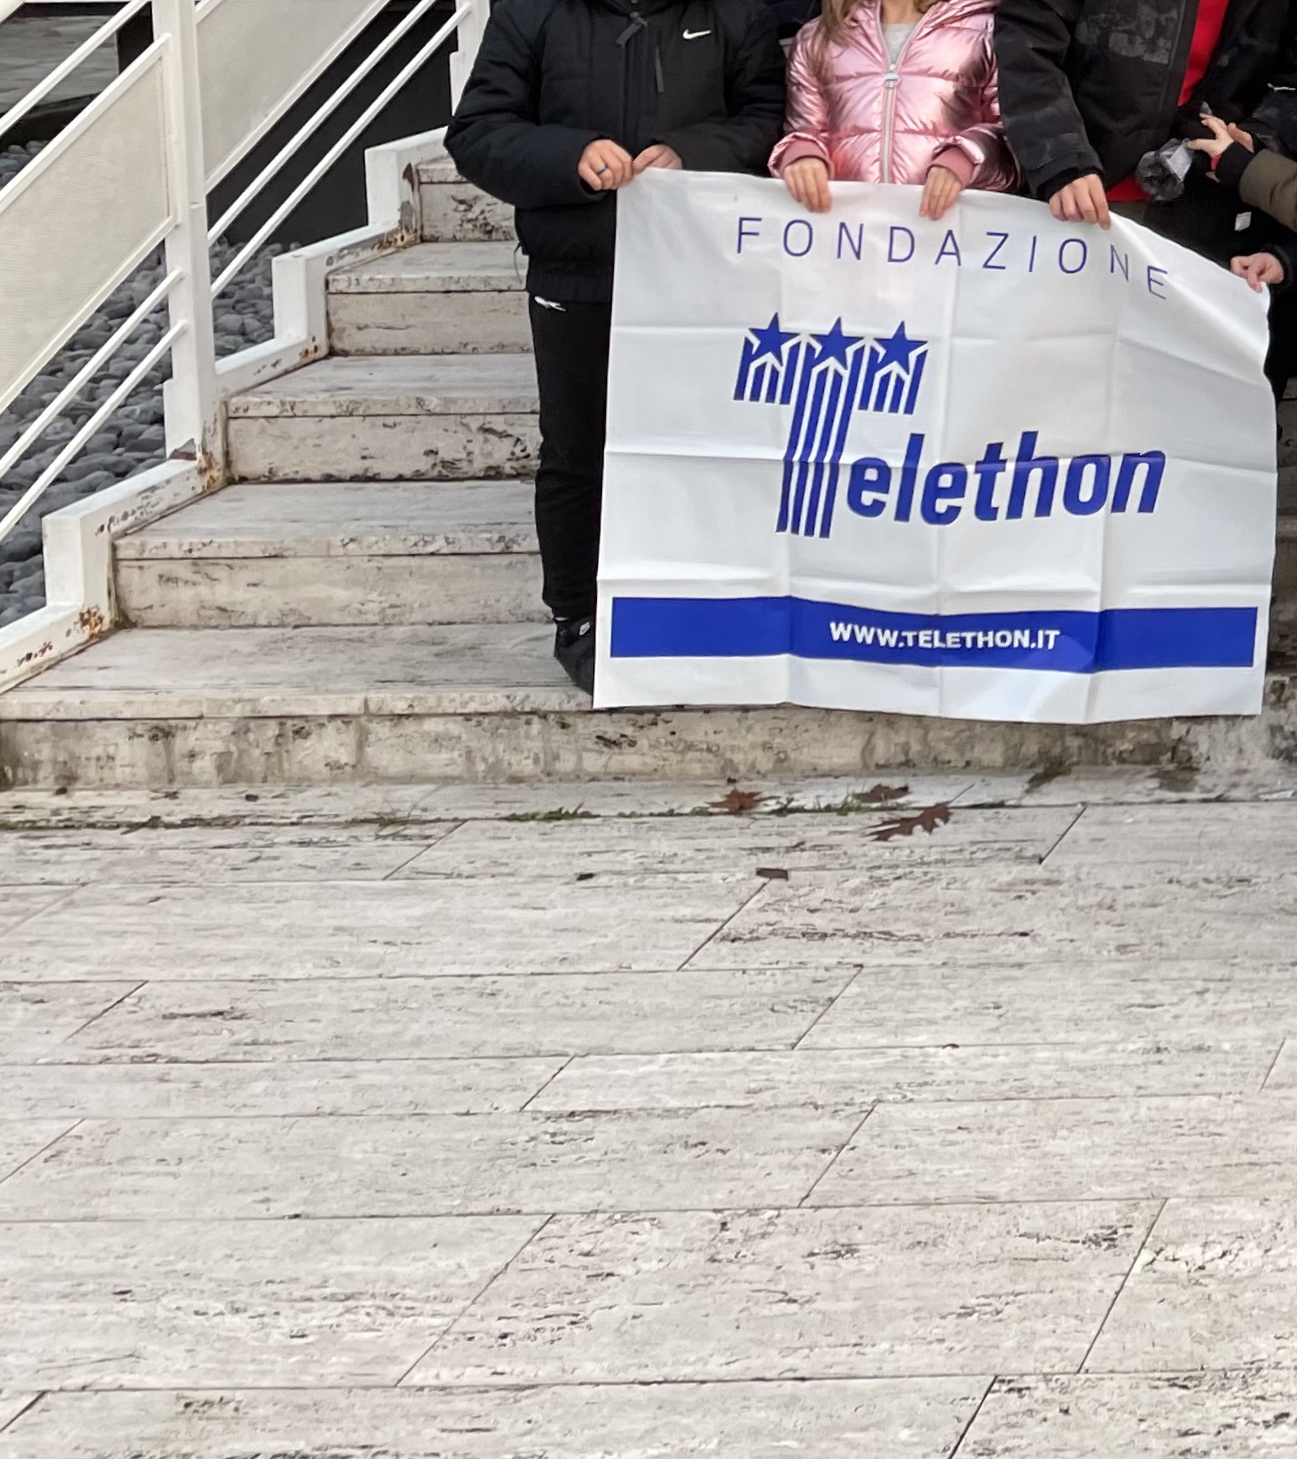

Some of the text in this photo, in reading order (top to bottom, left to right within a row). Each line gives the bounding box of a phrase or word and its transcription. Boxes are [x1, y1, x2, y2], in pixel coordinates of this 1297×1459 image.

[737, 217, 1168, 300] FONDAZIONE
[733, 312, 1167, 539] Telethon
[829, 621, 1061, 651] WWW.TELETHON.IT
